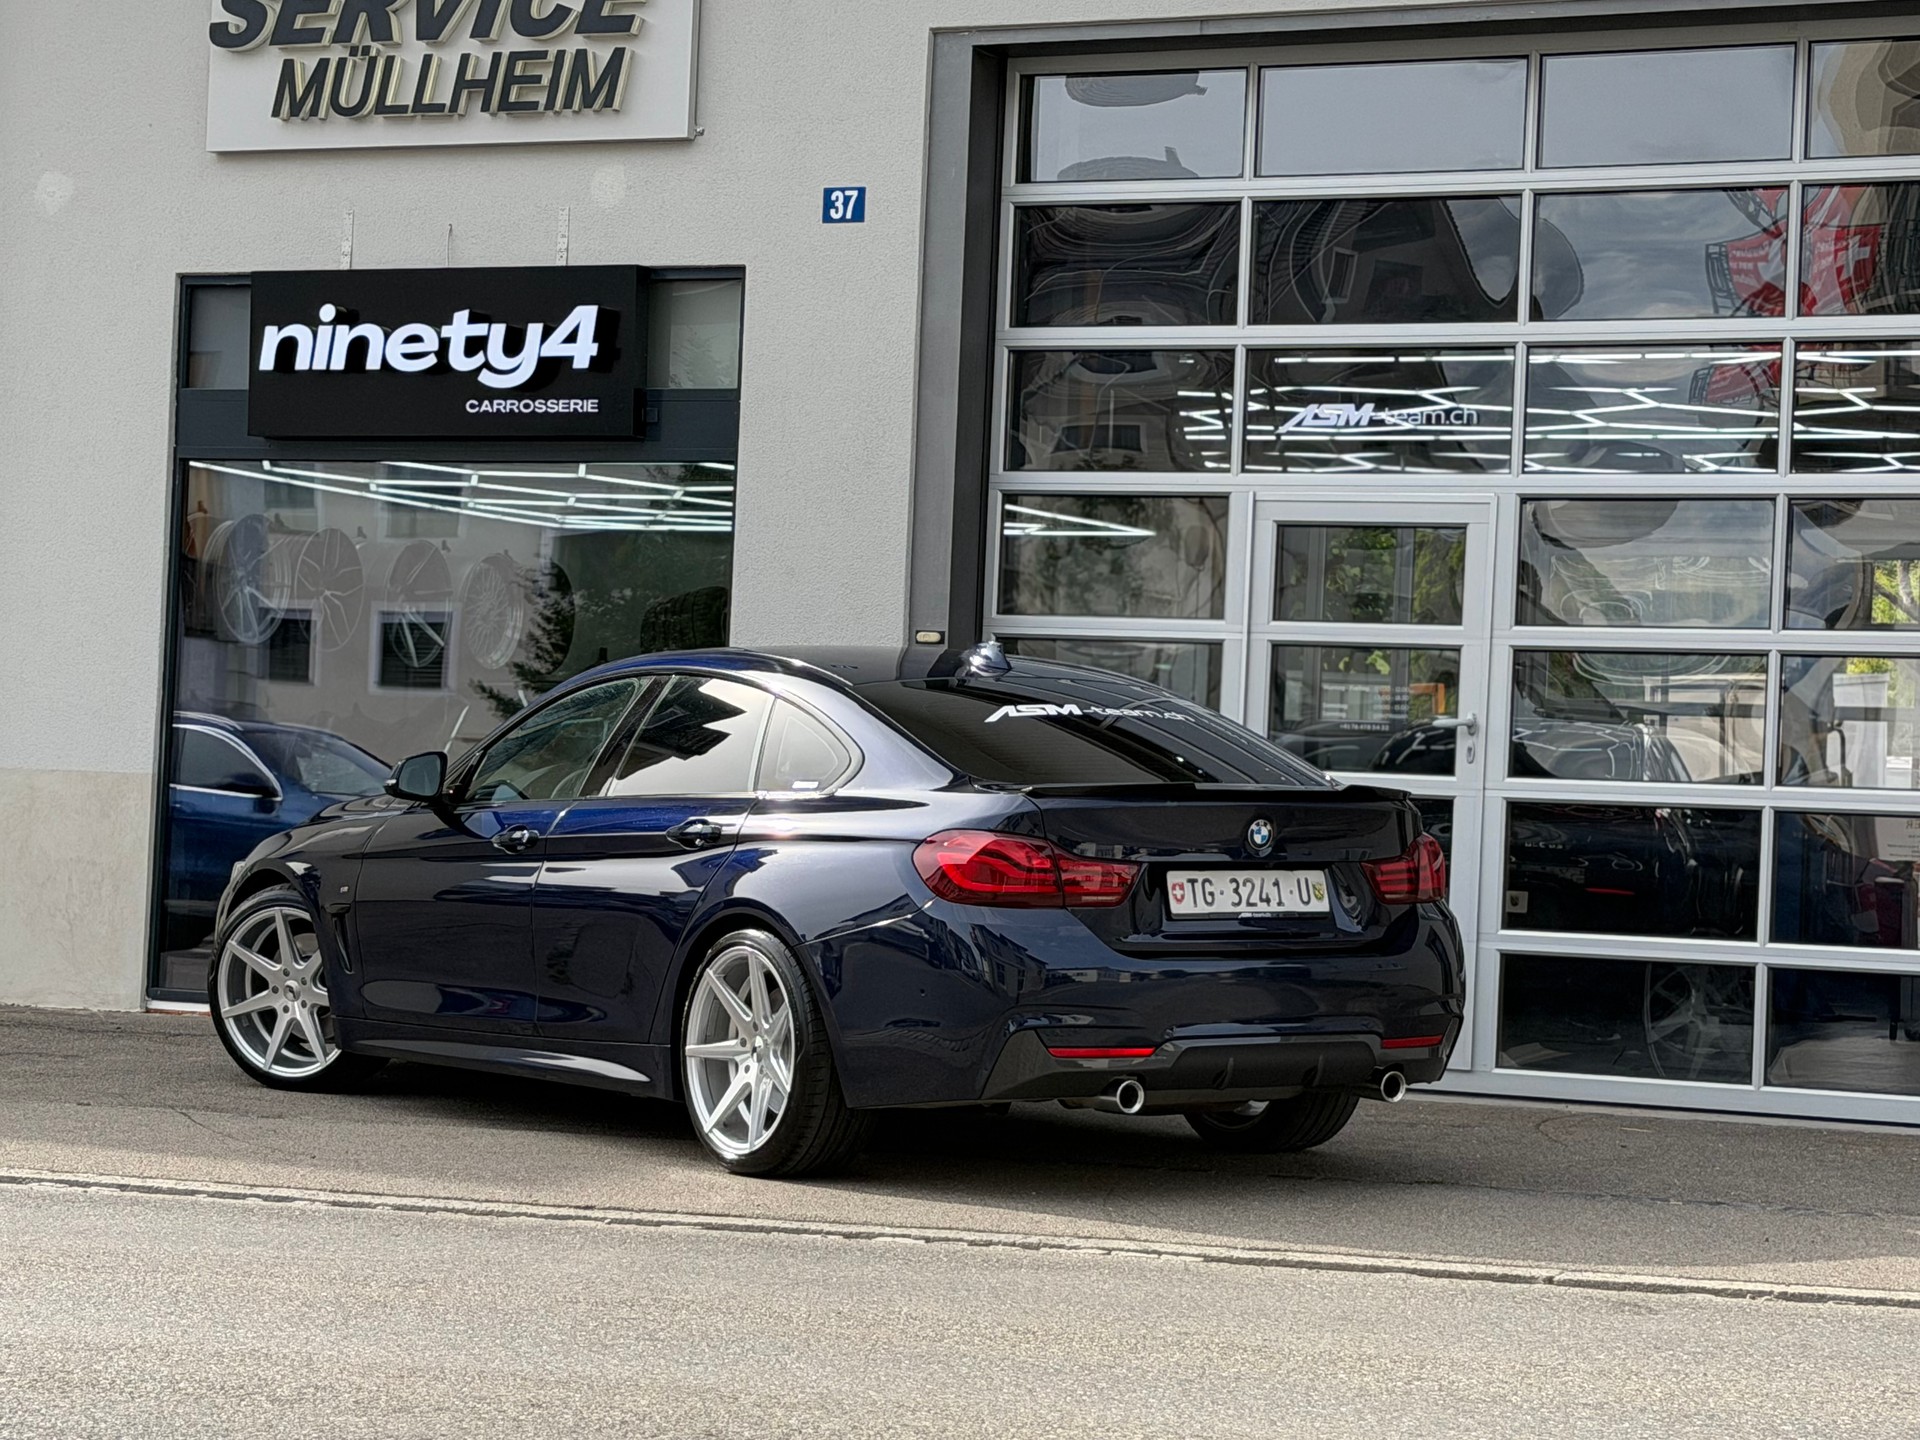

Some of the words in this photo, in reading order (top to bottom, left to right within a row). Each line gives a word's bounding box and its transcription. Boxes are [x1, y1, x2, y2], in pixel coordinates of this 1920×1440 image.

[271, 46, 630, 120] MÜLLHEIM
[829, 190, 859, 220] 37
[258, 303, 600, 389] ninety4
[465, 399, 600, 414] CARROSSERIE
